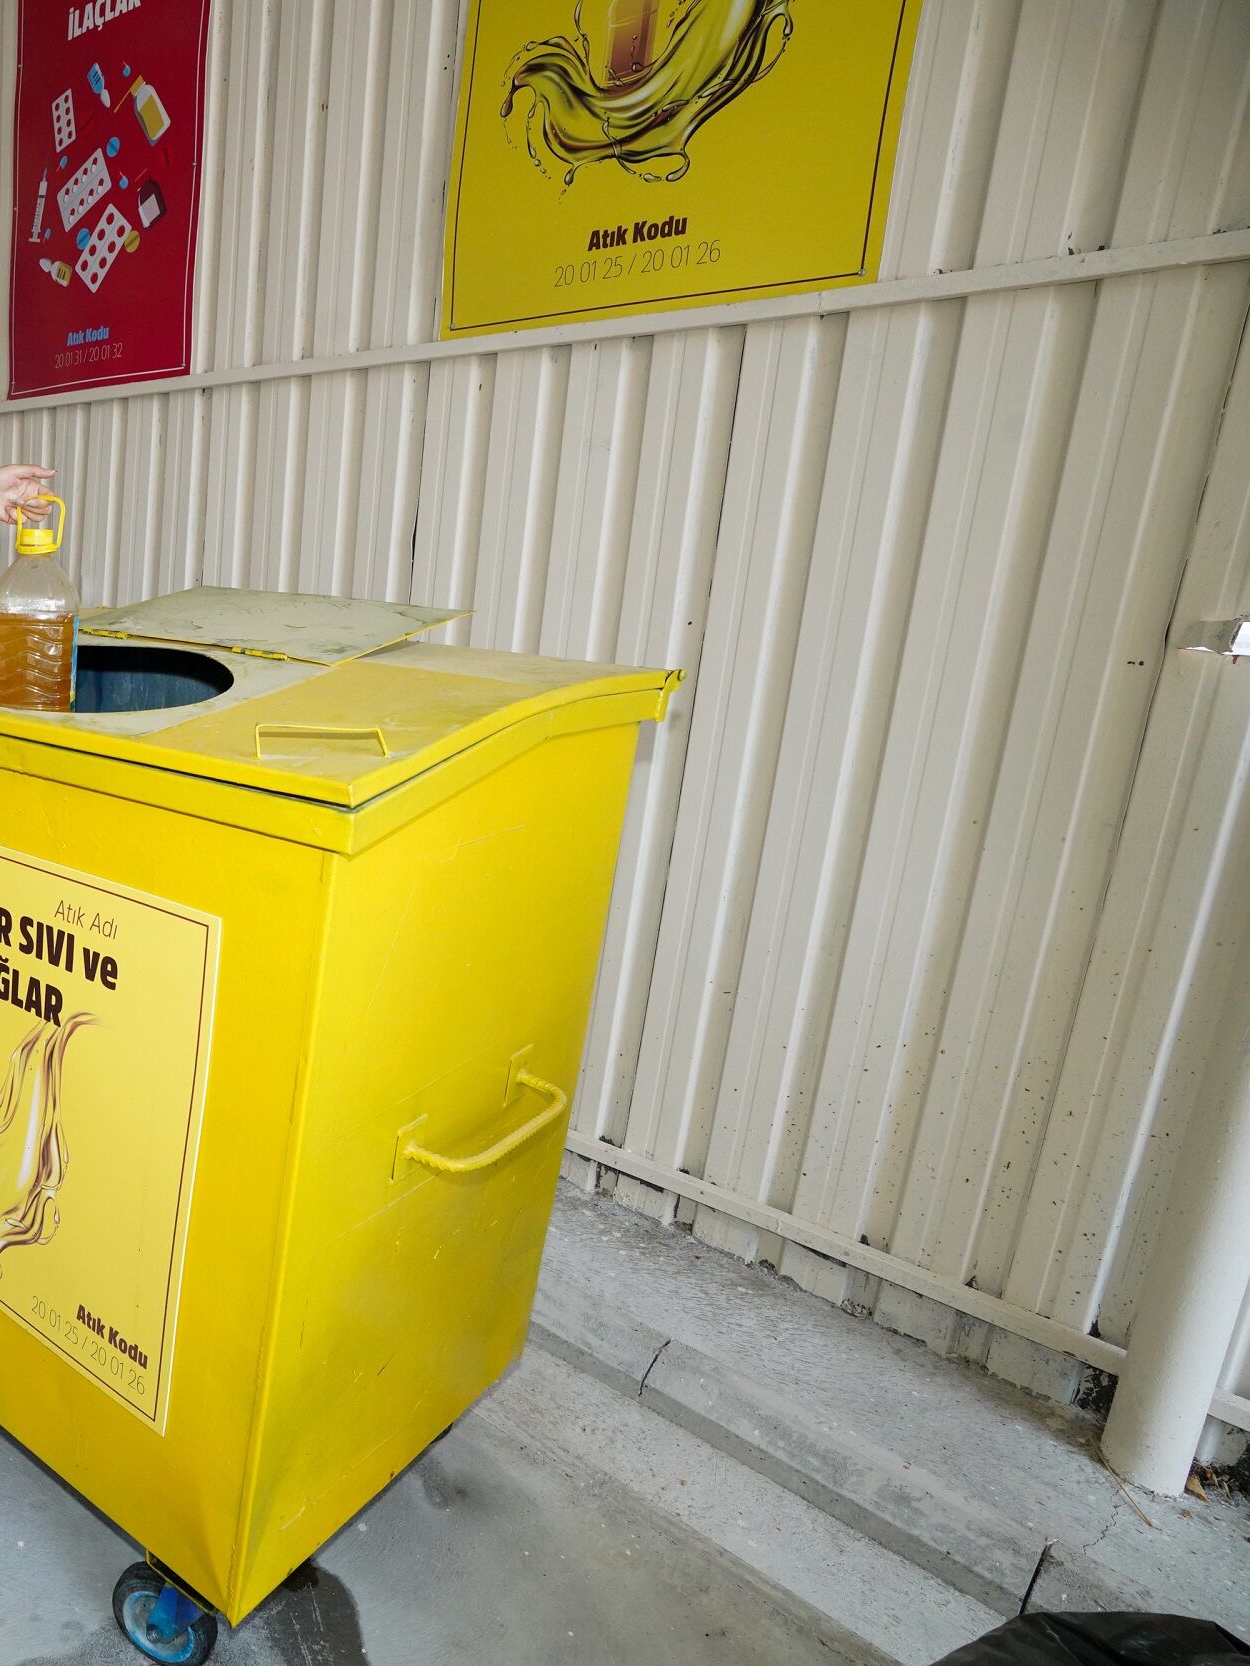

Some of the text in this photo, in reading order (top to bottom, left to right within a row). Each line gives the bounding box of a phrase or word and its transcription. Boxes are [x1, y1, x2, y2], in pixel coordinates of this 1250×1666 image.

[587, 215, 688, 252] Atık Kodu
[554, 264, 575, 288] 20
[579, 260, 597, 283] 01
[602, 255, 623, 280] 25
[641, 248, 665, 274] 20
[670, 244, 690, 269] 01
[696, 239, 722, 265] 26
[54, 353, 64, 369] 20
[89, 346, 100, 362] 20
[112, 342, 123, 359] 32
[66, 325, 109, 347] Atık Kodu
[54, 900, 118, 940] Atık Adı
[19, 915, 75, 973] SIVI
[82, 947, 118, 991] ve
[31, 1295, 46, 1320] 20
[49, 1309, 61, 1331] 01
[64, 1321, 79, 1345] 25
[90, 1340, 107, 1366] 20
[110, 1356, 124, 1380] 01
[127, 1368, 145, 1396] 26
[76, 1304, 148, 1370] Atık Kodu
